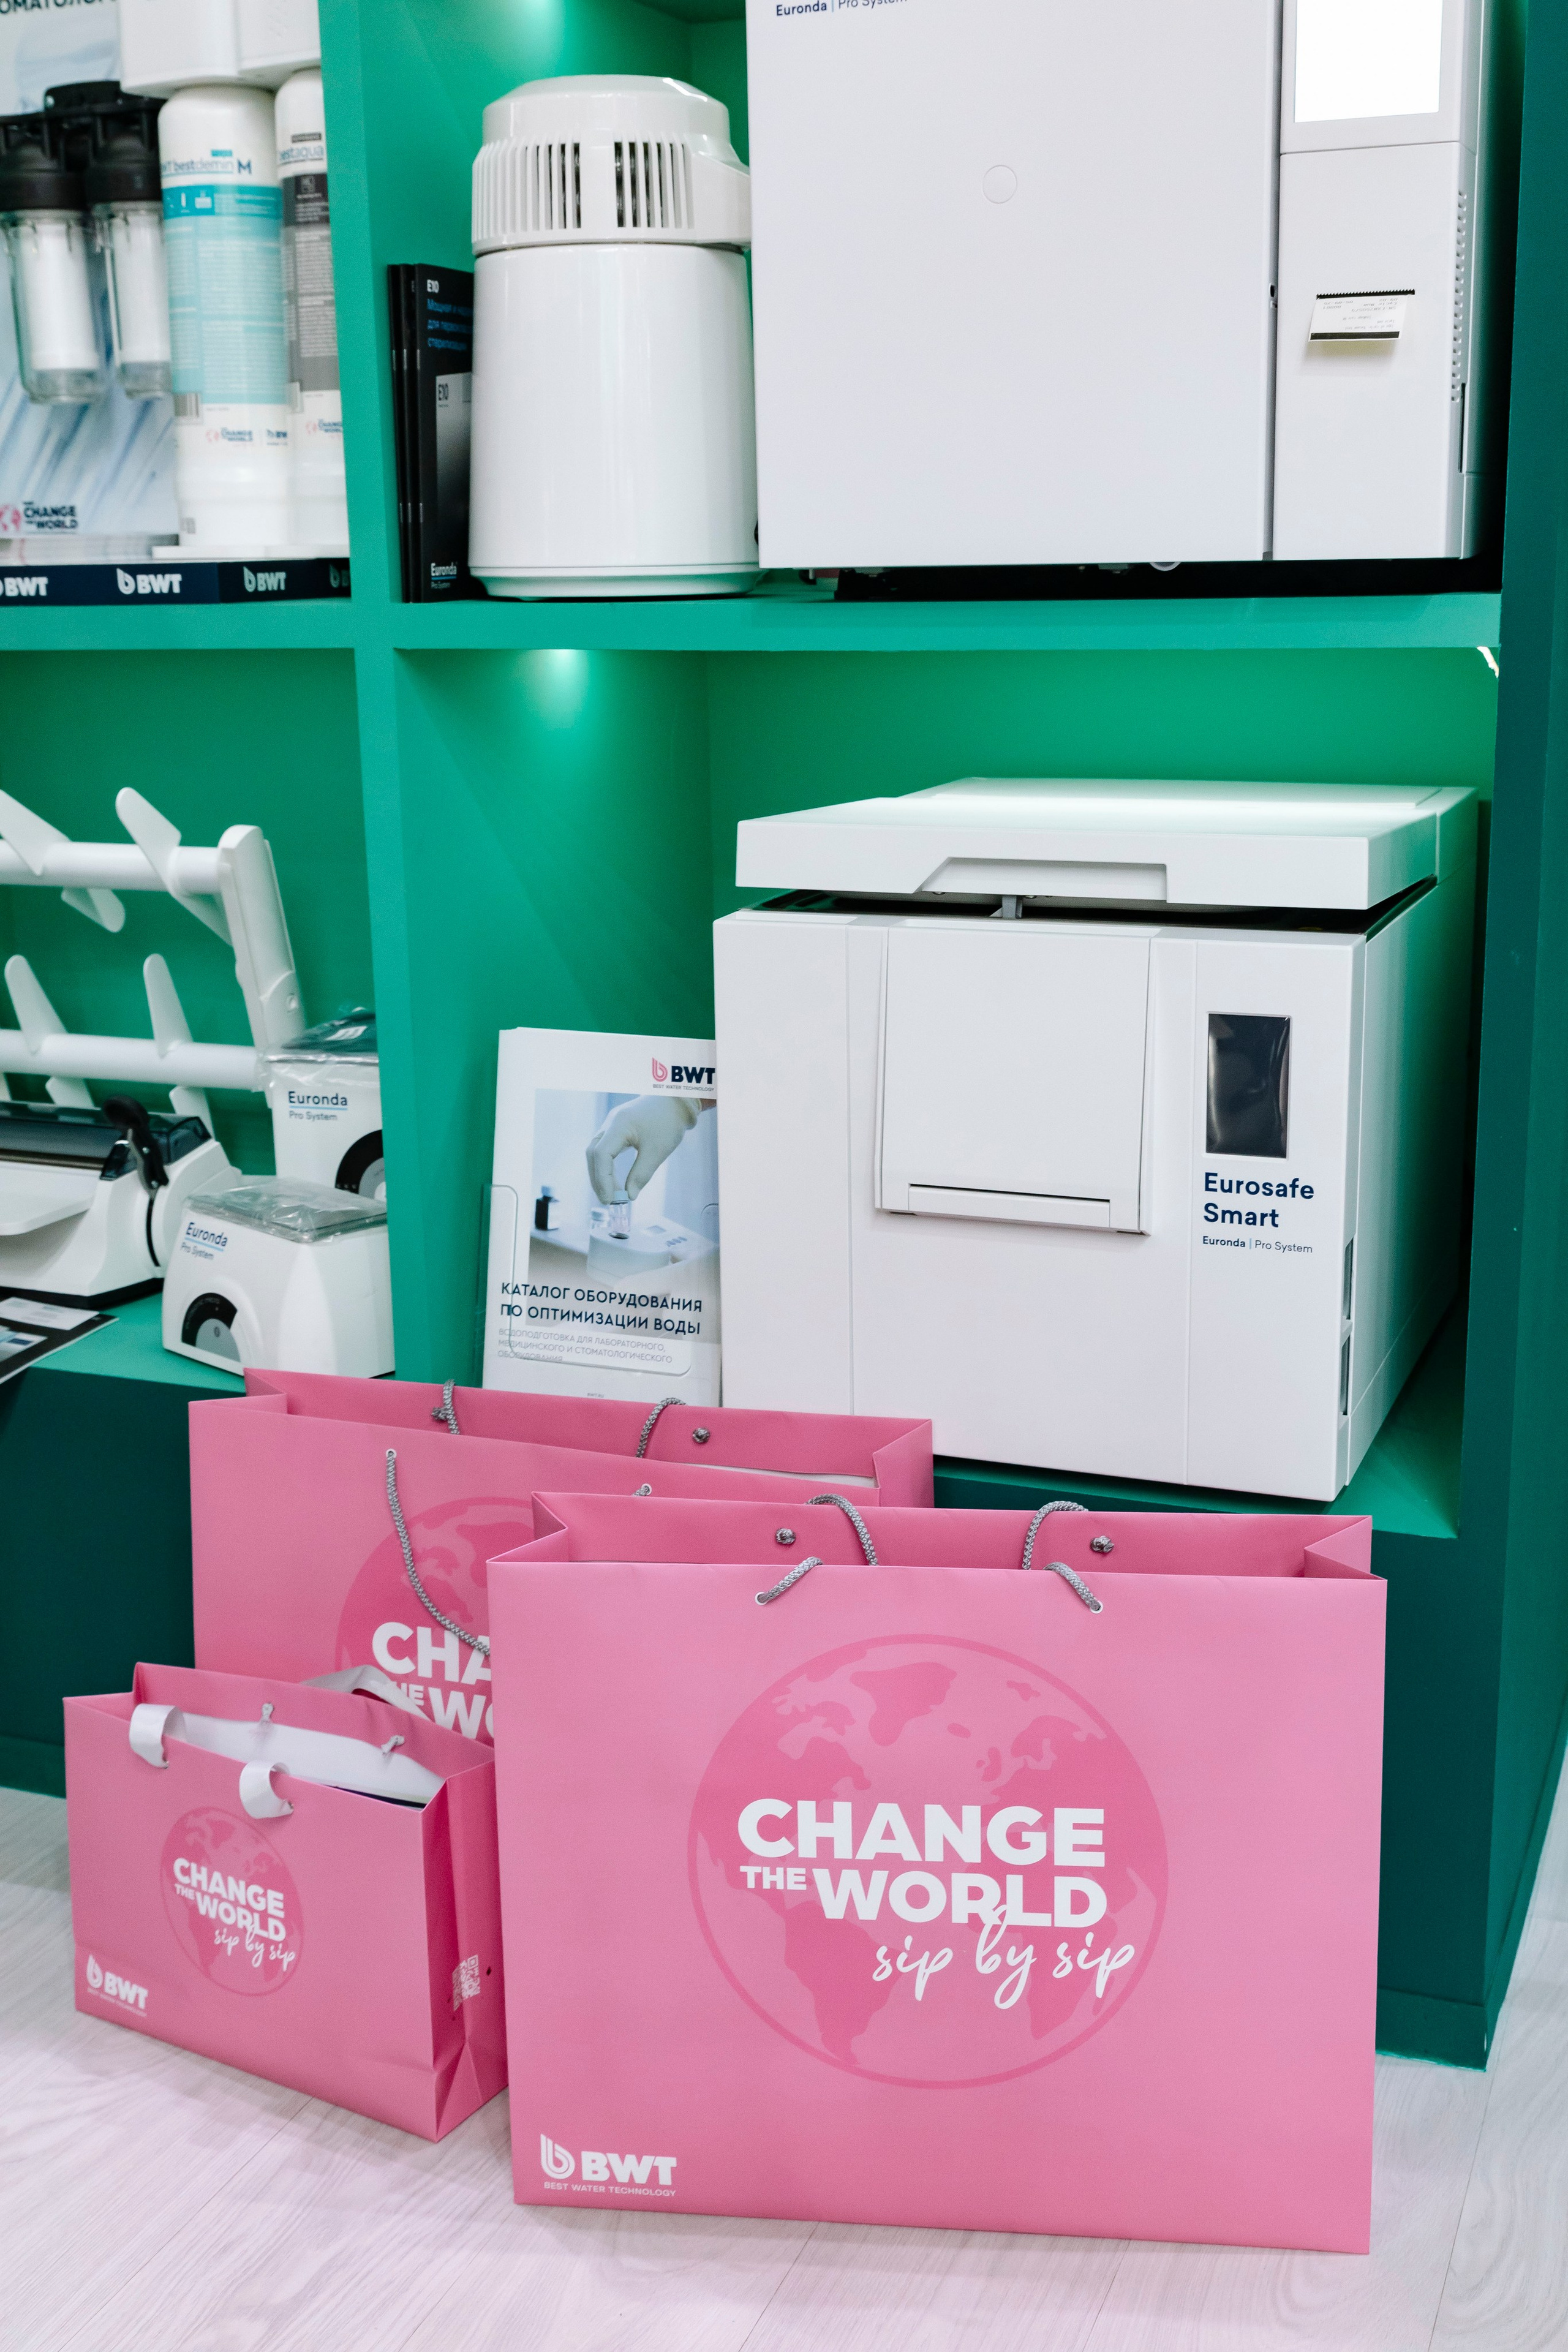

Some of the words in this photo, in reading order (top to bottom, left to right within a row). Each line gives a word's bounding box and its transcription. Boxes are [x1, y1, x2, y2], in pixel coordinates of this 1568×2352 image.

[776, 1, 827, 16] Euronda
[839, 0, 858, 9] Pro
[862, 0, 907, 9] Sys
[237, 159, 252, 174] M
[427, 279, 440, 293] E10
[431, 562, 457, 576] Euronda
[4, 576, 48, 597] BWT
[136, 573, 182, 594] BWT
[257, 571, 287, 592] BWT
[671, 1065, 715, 1085] BWT
[288, 1091, 348, 1106] Euronda
[289, 1110, 304, 1120] Pro
[306, 1111, 337, 1122] System
[1204, 1172, 1314, 1199] Eurosafe
[1203, 1202, 1279, 1228] Smart
[186, 1222, 228, 1246] Euronda
[1202, 1235, 1246, 1248] Euronda
[1255, 1240, 1272, 1250] Pro
[1275, 1242, 1313, 1254] System
[502, 1282, 570, 1299] КАТАЛОГ
[574, 1289, 703, 1313] ОБОРУДОВАНИЯ
[500, 1304, 522, 1317] ПО
[527, 1306, 649, 1329] ОПТИМИЗАЦИИ
[654, 1317, 701, 1336] ВОДЫ
[499, 1328, 575, 1341] ВОДОПОДГОТОВКА
[576, 1335, 593, 1344] ДЛЯ
[575, 1346, 673, 1363] СТОМАТОЛОГИЧЕСКОГО
[372, 1621, 491, 1684] CHA
[737, 1798, 1106, 1868] CHANGE
[173, 1857, 285, 1918] CHANGE
[739, 1865, 807, 1891] THE
[812, 1868, 1107, 1928] WORLD
[174, 1883, 195, 1901] THE
[195, 1891, 286, 1942] WORLD
[214, 1928, 240, 1956] sip
[246, 1924, 265, 1968] by
[269, 1943, 296, 1972] sip
[872, 1935, 953, 2002] sip
[975, 1904, 1037, 2010] by
[1052, 1932, 1136, 1999] sip
[104, 1971, 149, 2010] BWT
[581, 2150, 677, 2186] BWT
[544, 2181, 569, 2191] BEST
[571, 2183, 606, 2193] WATER
[608, 2186, 676, 2197] TECHNOLOGY
